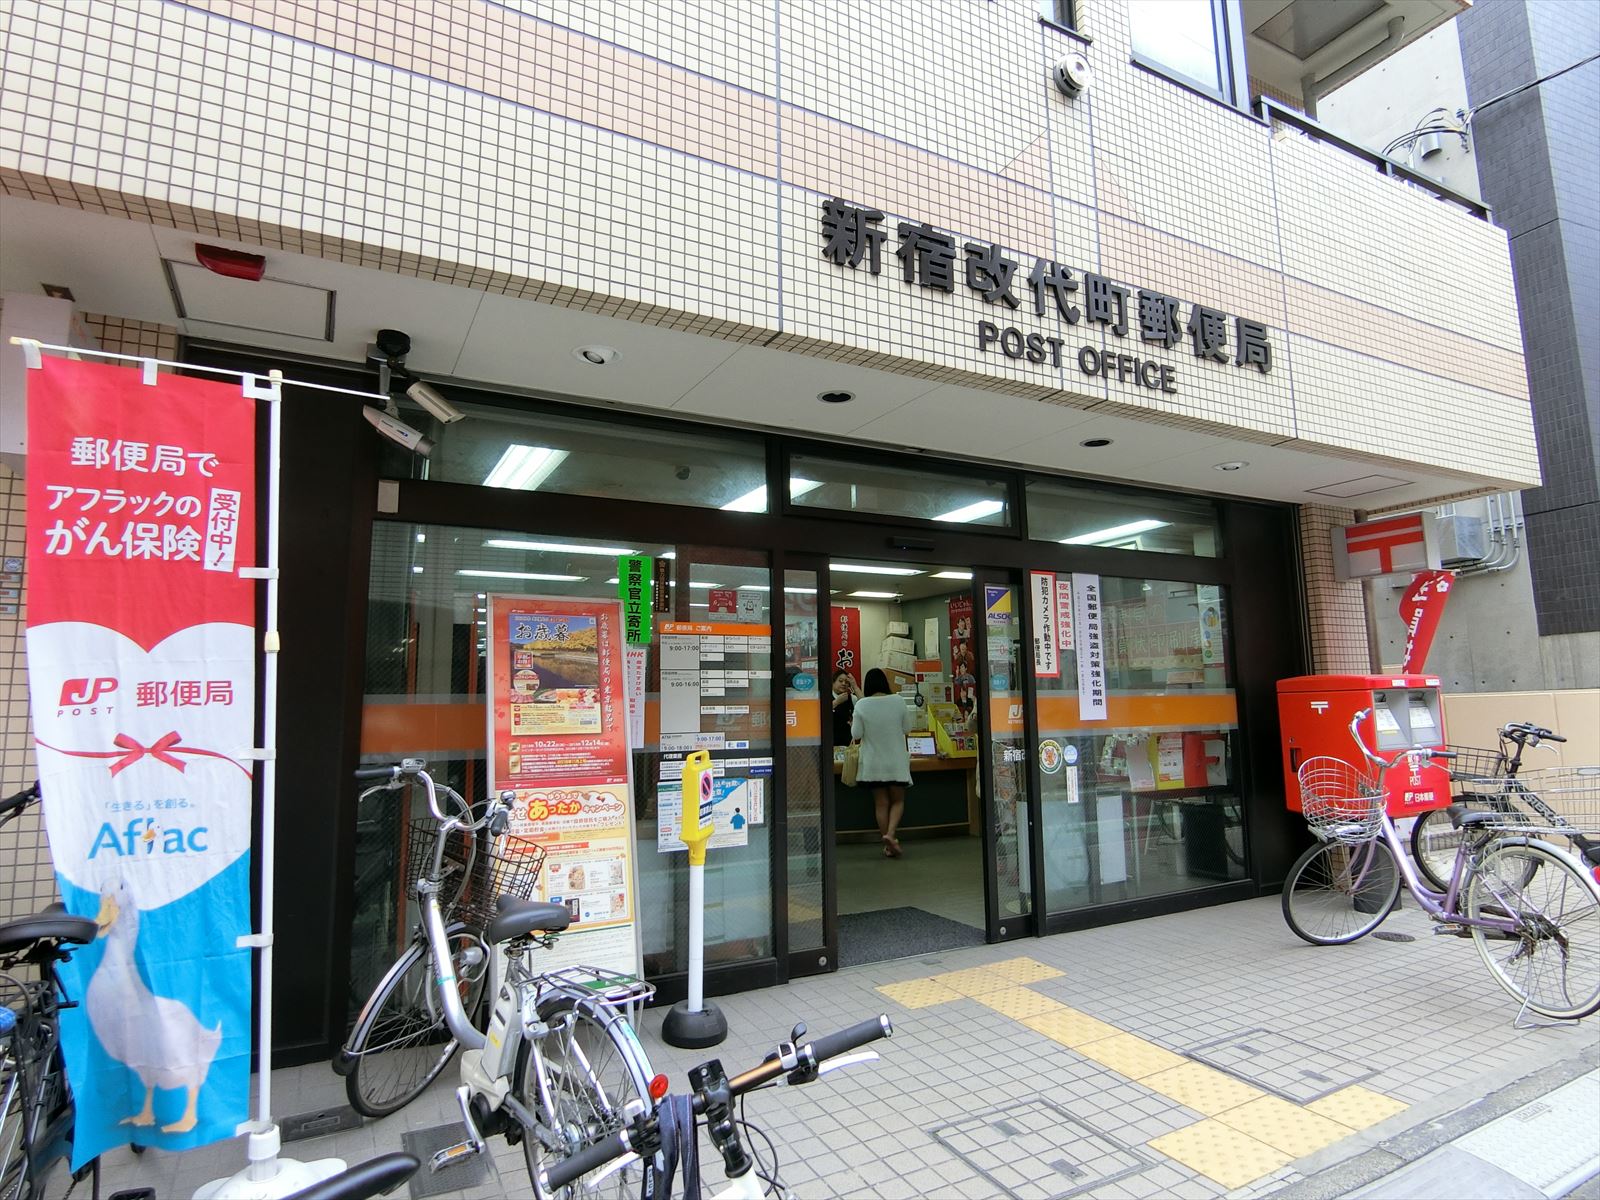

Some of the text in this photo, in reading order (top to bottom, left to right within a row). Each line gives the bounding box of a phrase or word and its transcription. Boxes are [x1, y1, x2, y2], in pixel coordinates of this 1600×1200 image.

[822, 197, 1273, 374] 新宿改代町郵便局
[979, 320, 1178, 394] POST OFFICE
[71, 436, 219, 478] 郵便局で
[46, 485, 202, 518] アフラックの
[45, 517, 203, 562] がん保険
[626, 559, 643, 642] 警察官立寄所
[1058, 582, 1072, 648] 夜間警戒強化中
[515, 622, 570, 642] お歳暮
[1040, 576, 1052, 671] 防犯カメラ作動中です
[1086, 584, 1103, 706] 全国郵便局強盗対策強化期間
[57, 706, 114, 718] POST
[136, 680, 233, 707] 郵便局
[1409, 775, 1422, 786] POST
[104, 798, 195, 813] 「生きる」を創る。
[87, 817, 209, 860] Aflac
